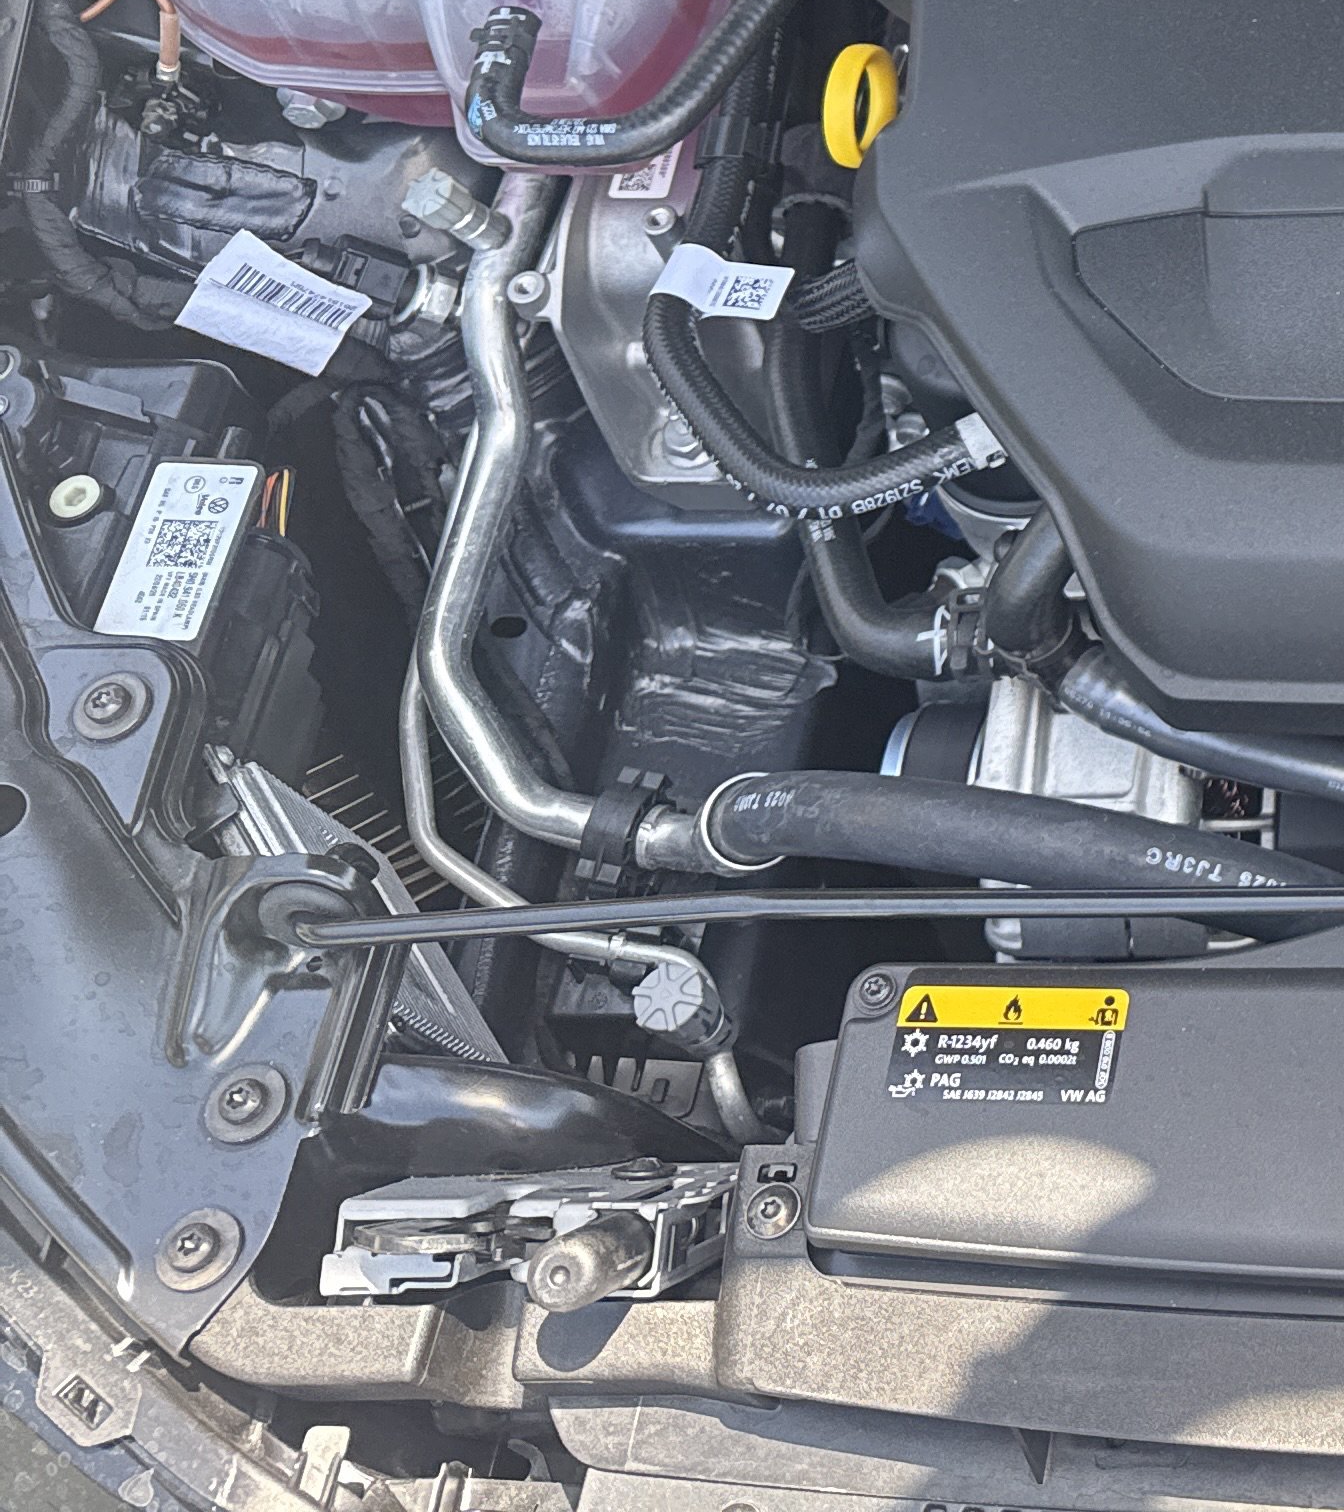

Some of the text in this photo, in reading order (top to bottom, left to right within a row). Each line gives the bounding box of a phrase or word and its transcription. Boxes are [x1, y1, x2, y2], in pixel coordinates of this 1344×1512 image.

[1145, 846, 1222, 882] TJ3RC
[938, 1034, 1080, 1054] R-1234yf 0.460 kg
[934, 1054, 961, 1064] GWP
[960, 1054, 987, 1065] 0.501
[1022, 1056, 1035, 1066] eq
[930, 1072, 962, 1088] PAG
[1060, 1089, 1106, 1103] VW AG
